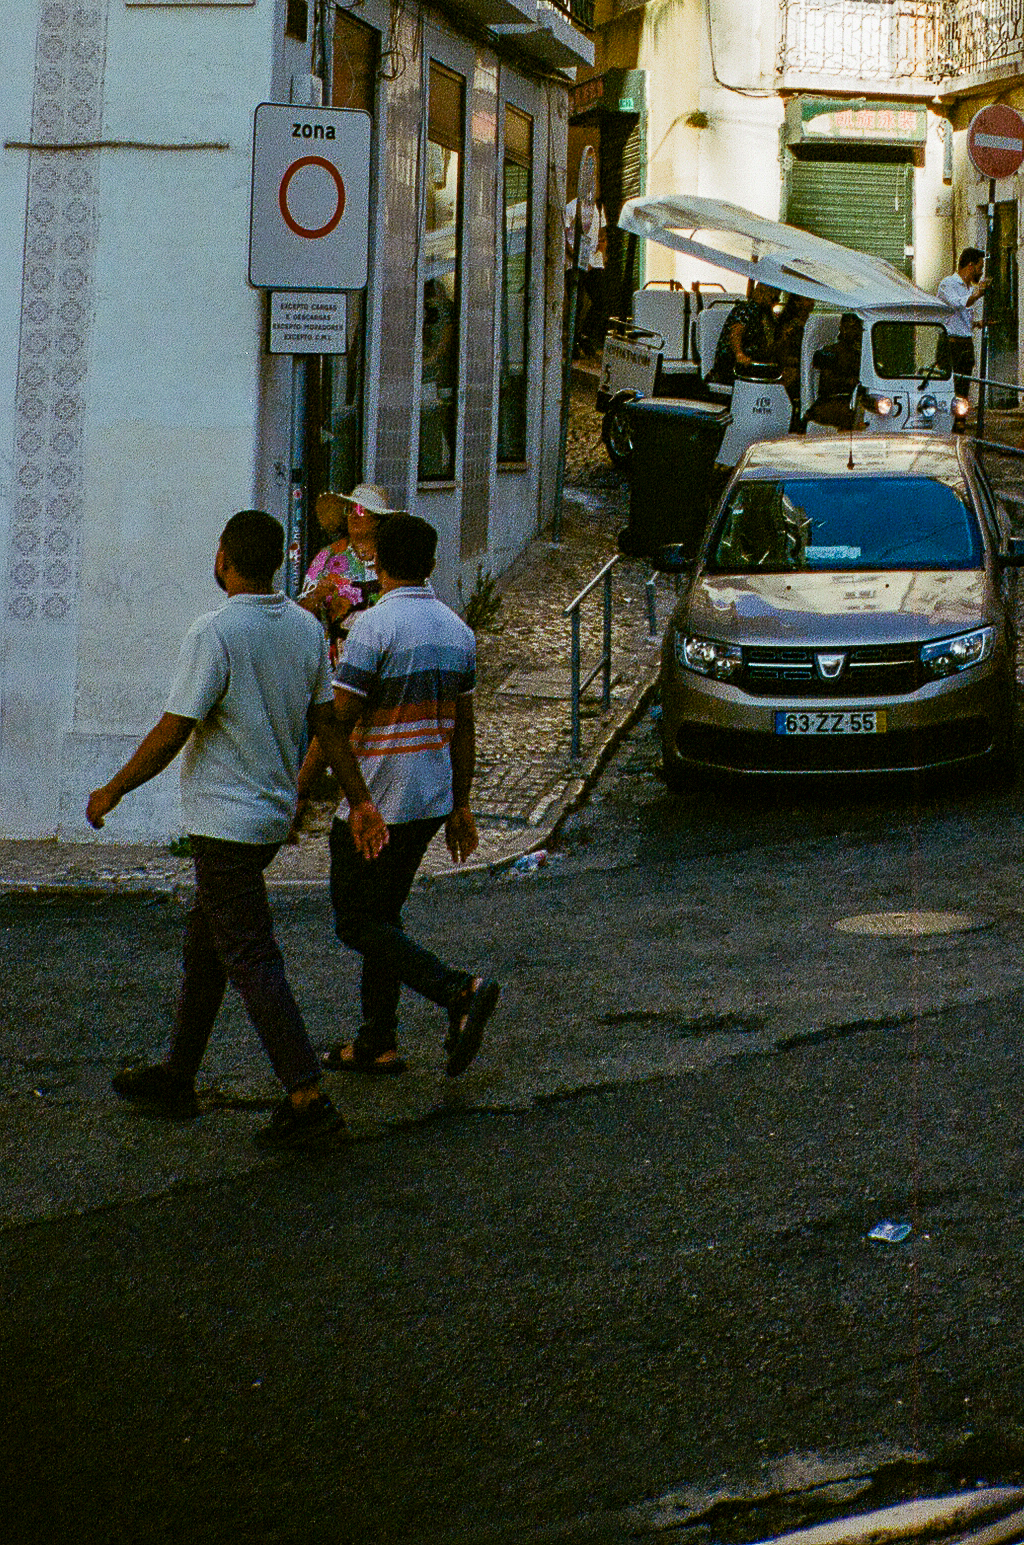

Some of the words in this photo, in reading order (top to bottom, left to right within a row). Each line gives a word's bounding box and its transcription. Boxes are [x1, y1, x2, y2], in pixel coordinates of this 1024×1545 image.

[292, 123, 337, 140] zona
[311, 303, 338, 311] CARGAS
[892, 395, 903, 418] 5
